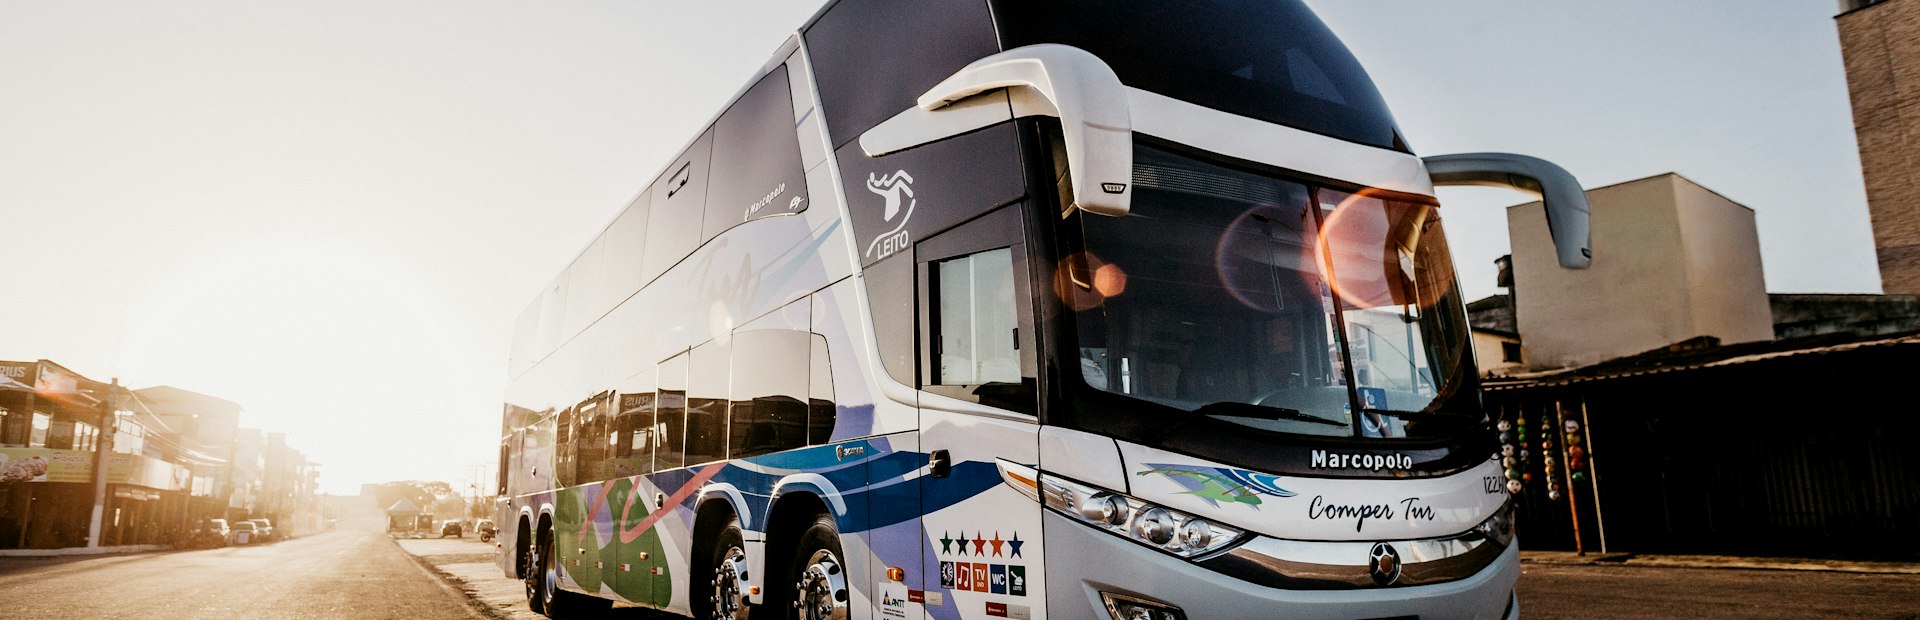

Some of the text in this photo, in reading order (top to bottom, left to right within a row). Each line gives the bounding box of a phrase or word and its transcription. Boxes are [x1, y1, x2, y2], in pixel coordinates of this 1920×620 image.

[877, 230, 909, 260] LEITO
[1311, 449, 1413, 471] Marcopolo
[1308, 495, 1436, 533] Comper Tur
[975, 569, 986, 581] TV
[991, 573, 1006, 586] WC
